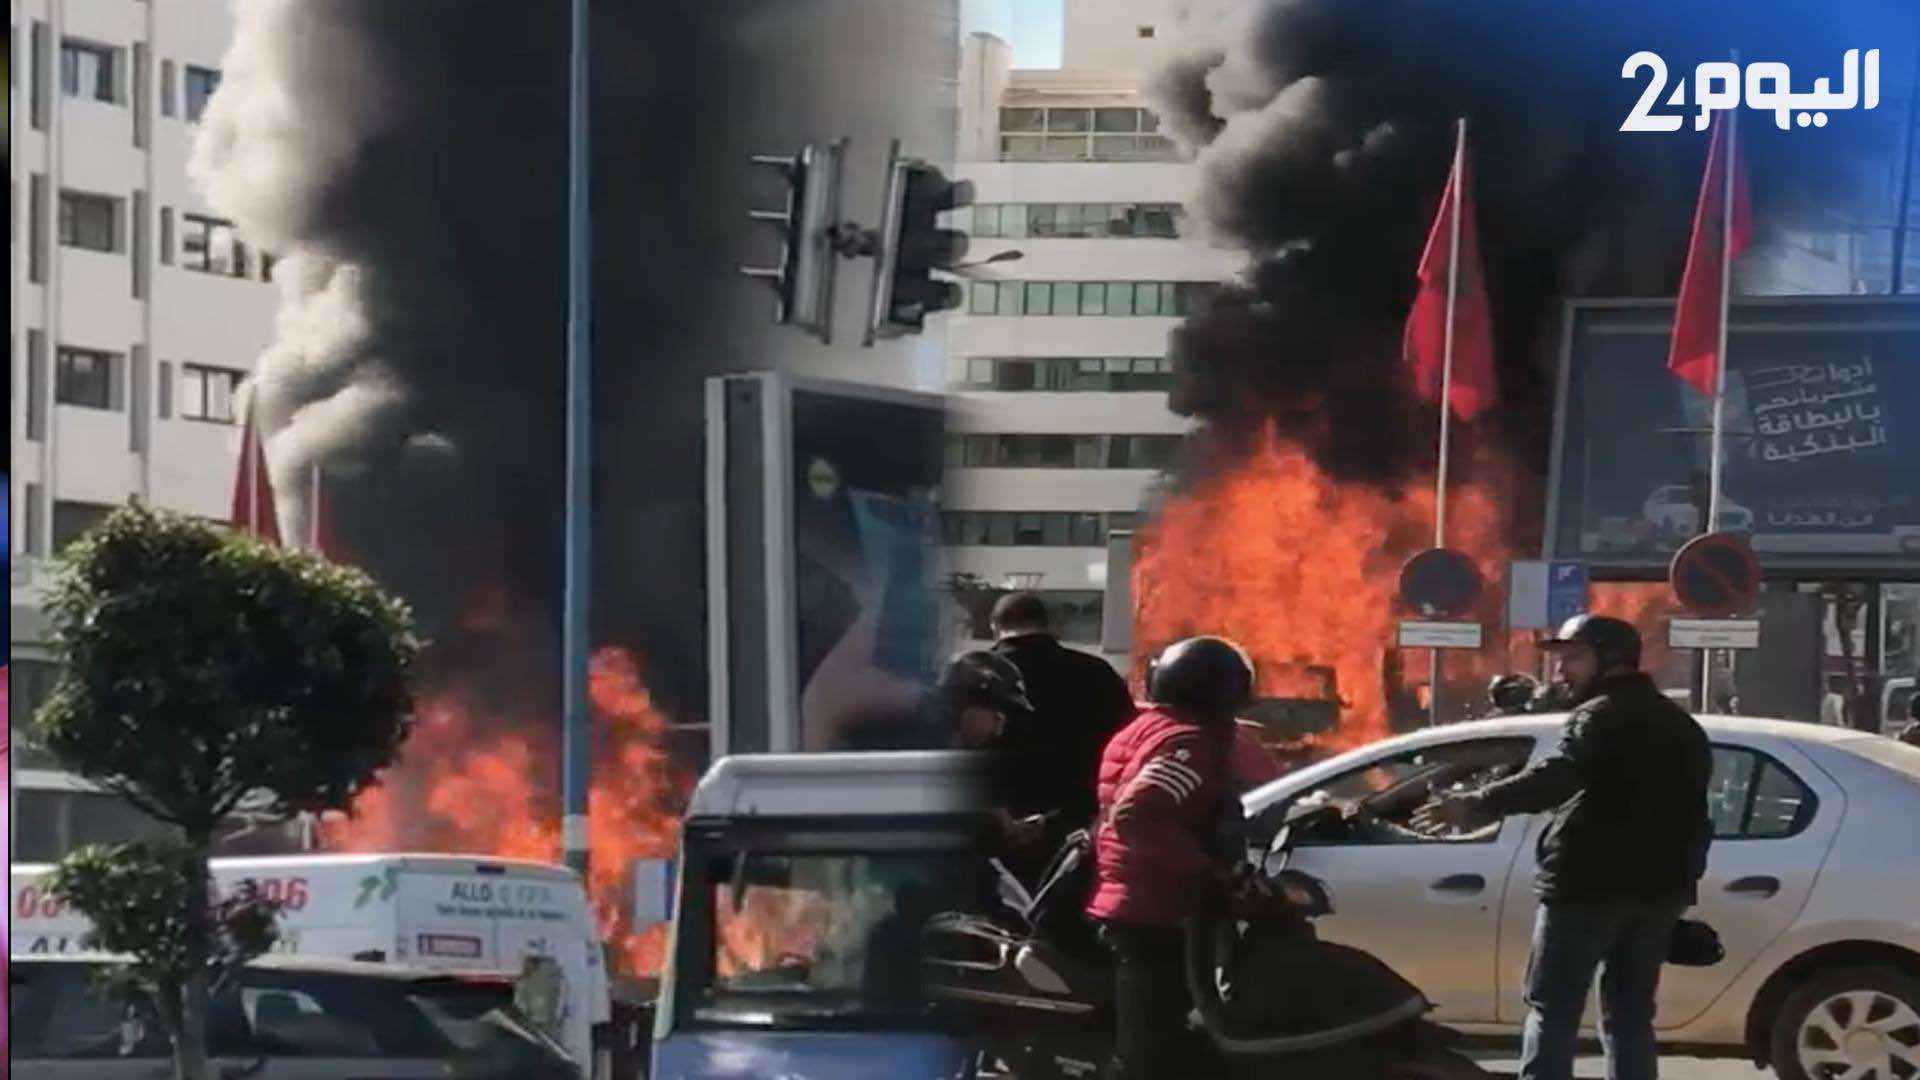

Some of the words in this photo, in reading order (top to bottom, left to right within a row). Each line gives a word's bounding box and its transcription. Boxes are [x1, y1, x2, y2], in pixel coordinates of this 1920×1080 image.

[1757, 402, 1882, 436] بالبطاقة
[1762, 424, 1888, 462] البنكية
[451, 881, 494, 903] ALLO
